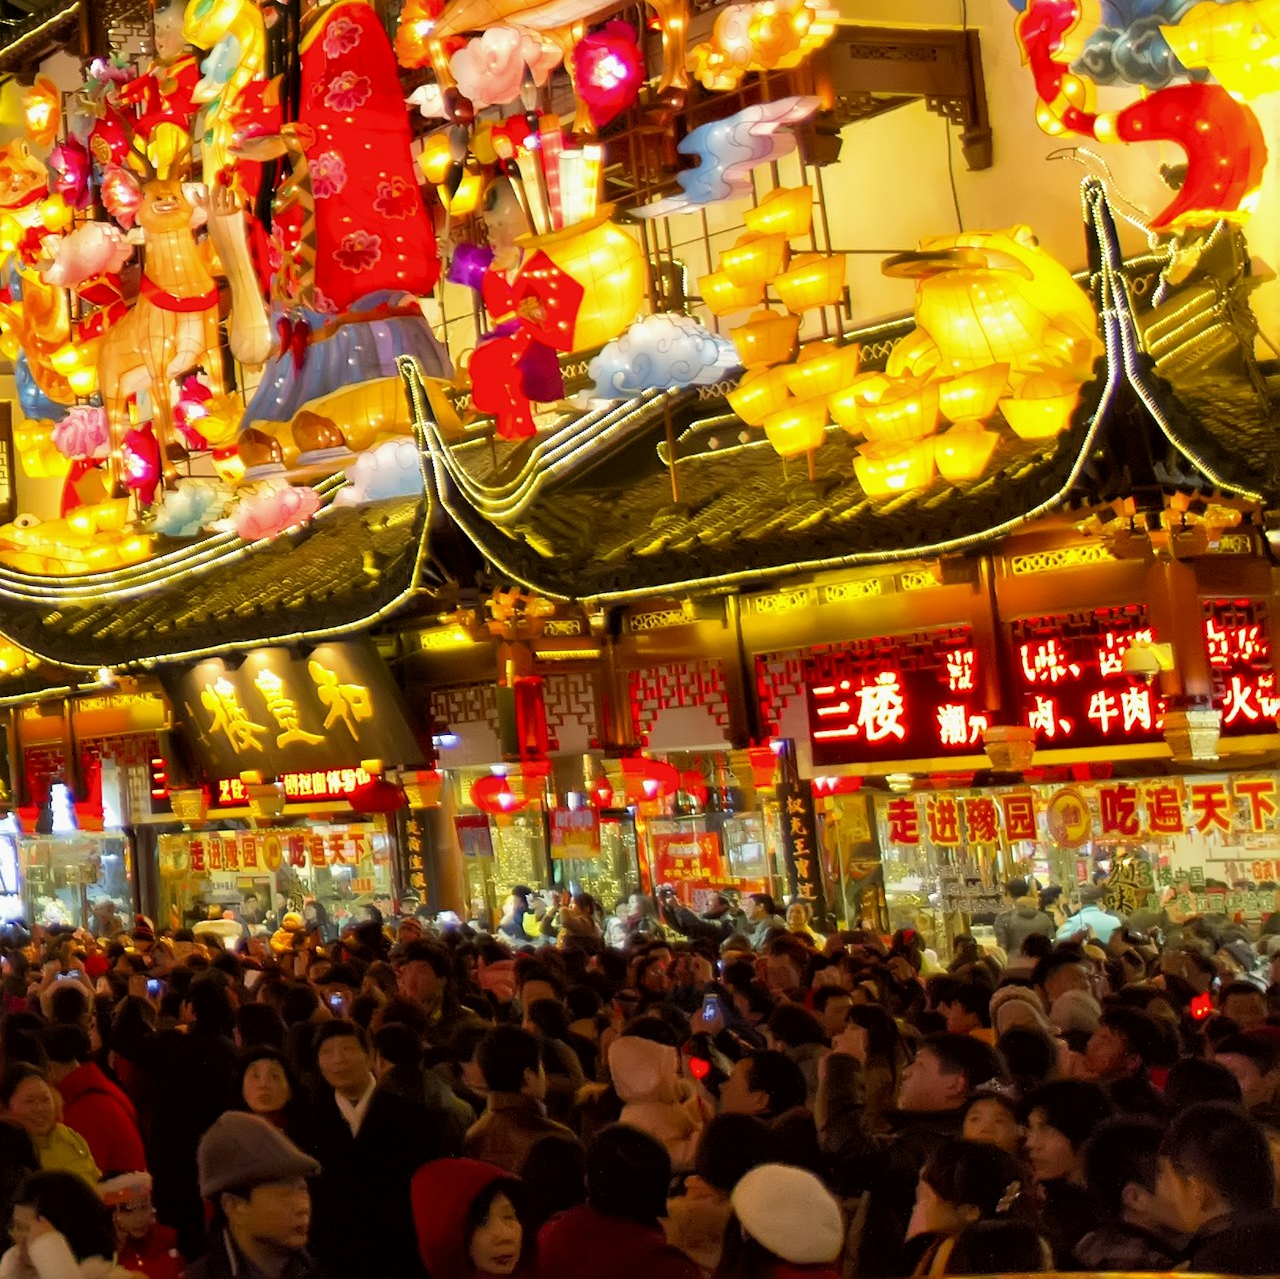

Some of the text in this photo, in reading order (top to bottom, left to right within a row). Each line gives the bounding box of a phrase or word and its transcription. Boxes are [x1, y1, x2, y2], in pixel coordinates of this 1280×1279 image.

[813, 672, 906, 741] 三楼
[887, 780, 1278, 846] 走进豫园 吃遍天下
[191, 837, 257, 871] 走进豫园
[289, 833, 366, 869] 吃遍天下
